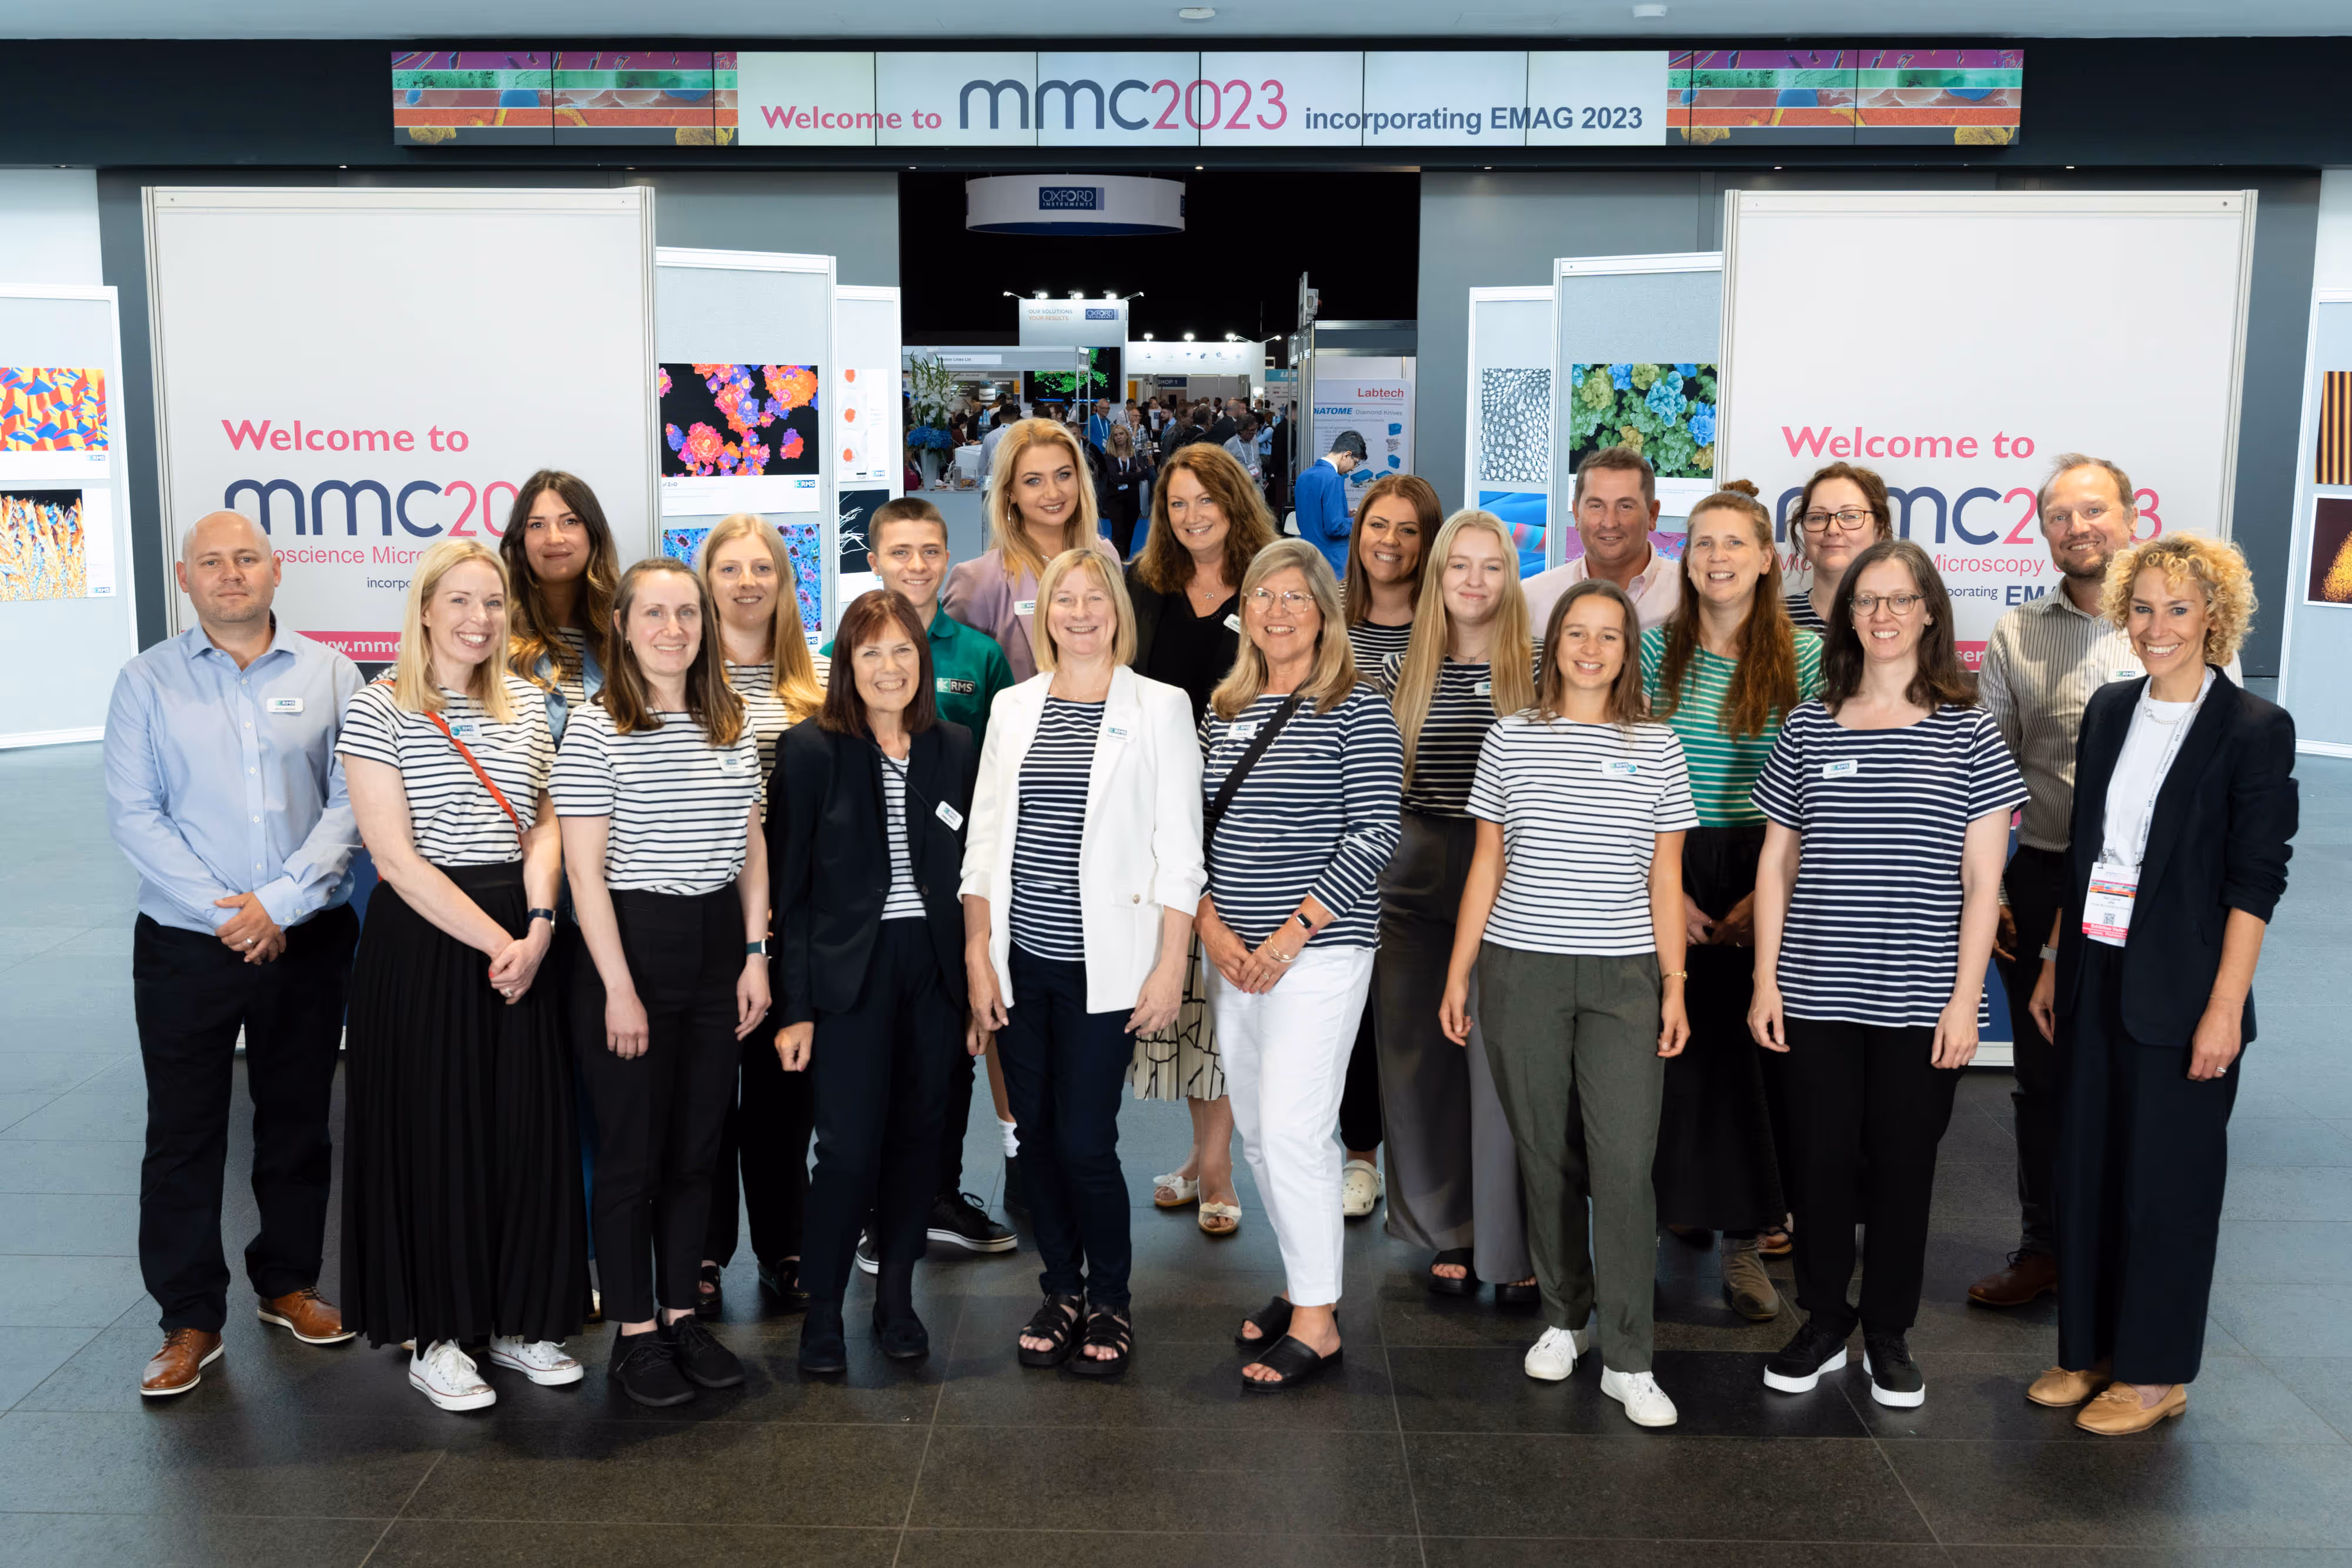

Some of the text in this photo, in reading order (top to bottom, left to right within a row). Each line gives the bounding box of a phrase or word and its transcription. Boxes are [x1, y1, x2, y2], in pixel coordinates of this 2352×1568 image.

[760, 79, 1643, 135] Welcome to mmc2023 incorporating EMAG 2023
[1042, 190, 1094, 202] OXFORD
[1358, 387, 1404, 397] Labtech
[220, 420, 469, 452] Welcome to
[1781, 426, 2035, 458] Welcome to
[224, 479, 519, 537] mmc20
[273, 546, 365, 563] oscience
[951, 681, 973, 693] RMS
